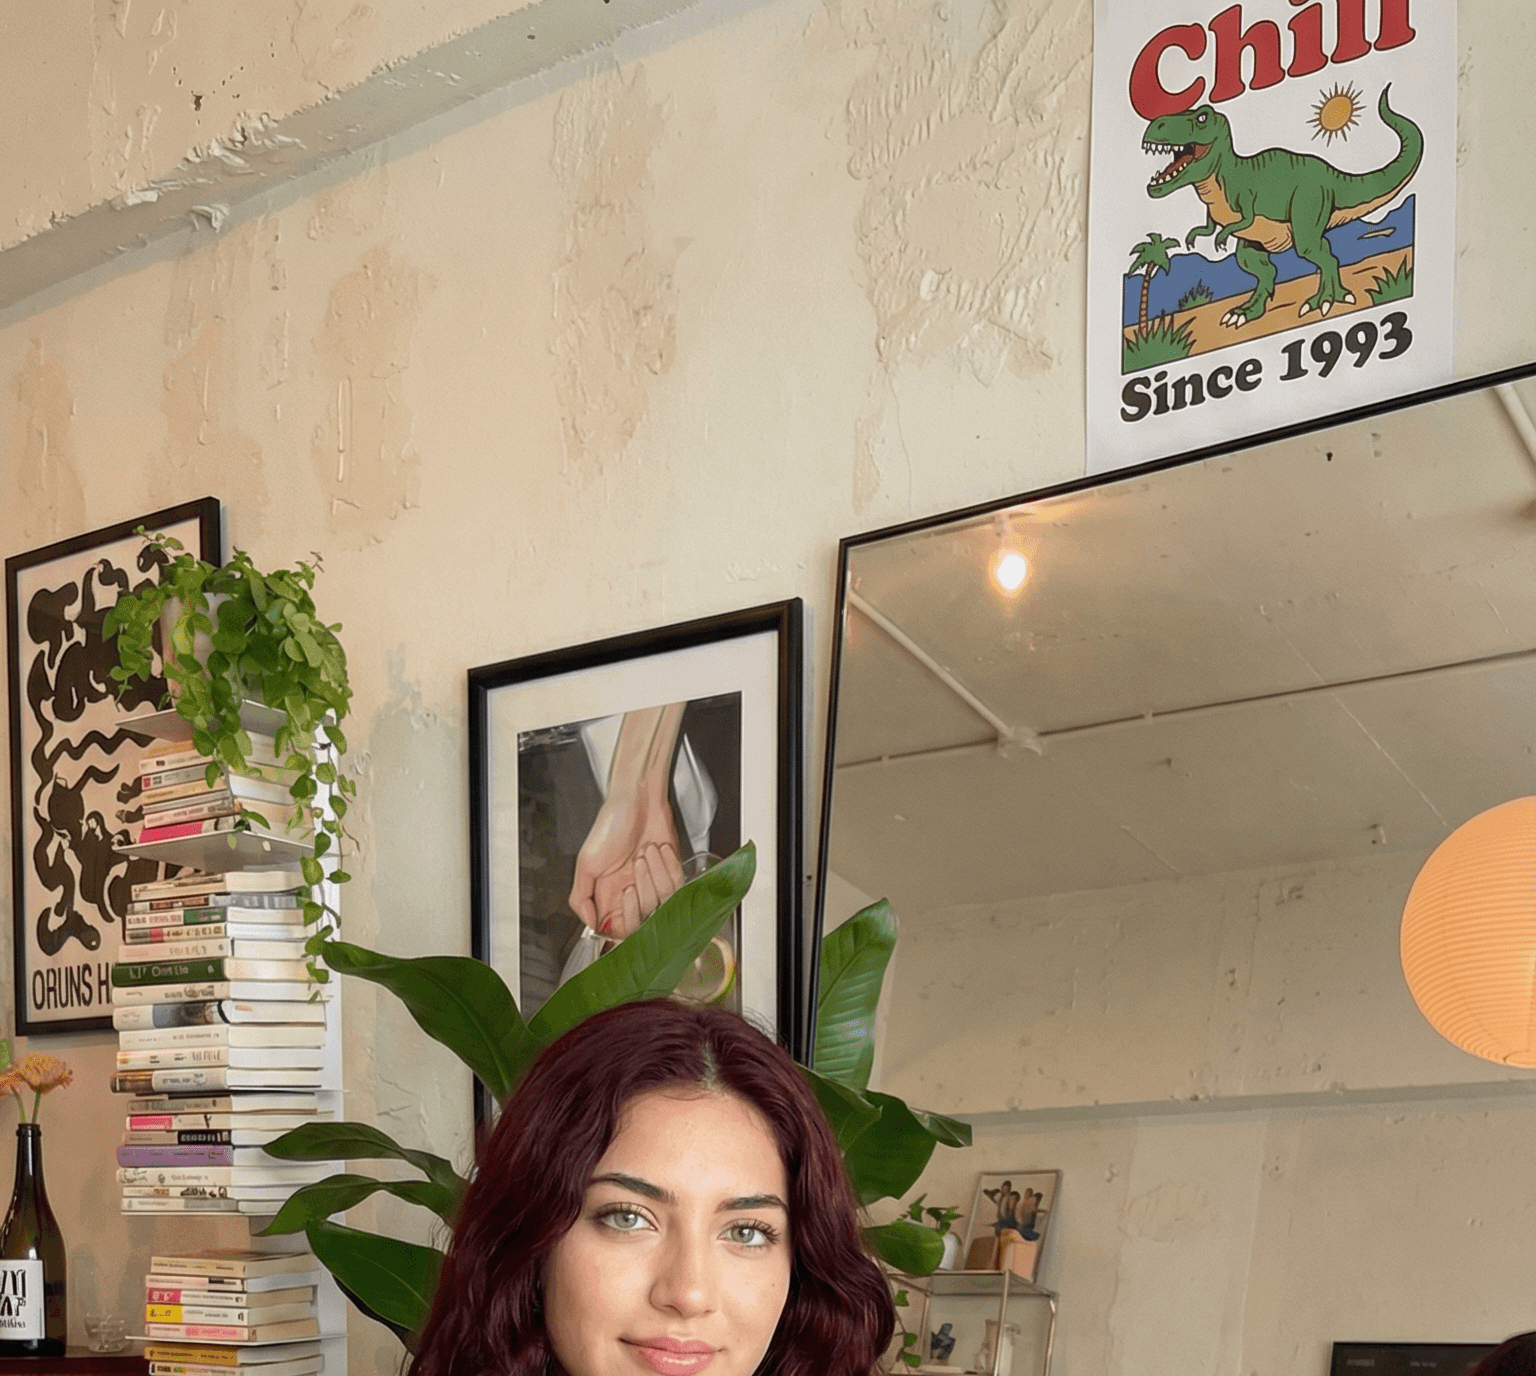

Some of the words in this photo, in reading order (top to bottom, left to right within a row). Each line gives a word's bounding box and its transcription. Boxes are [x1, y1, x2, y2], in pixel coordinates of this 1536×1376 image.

[1129, 0, 1416, 121] Chill
[1120, 358, 1263, 423] Since
[1279, 311, 1413, 381] 1993
